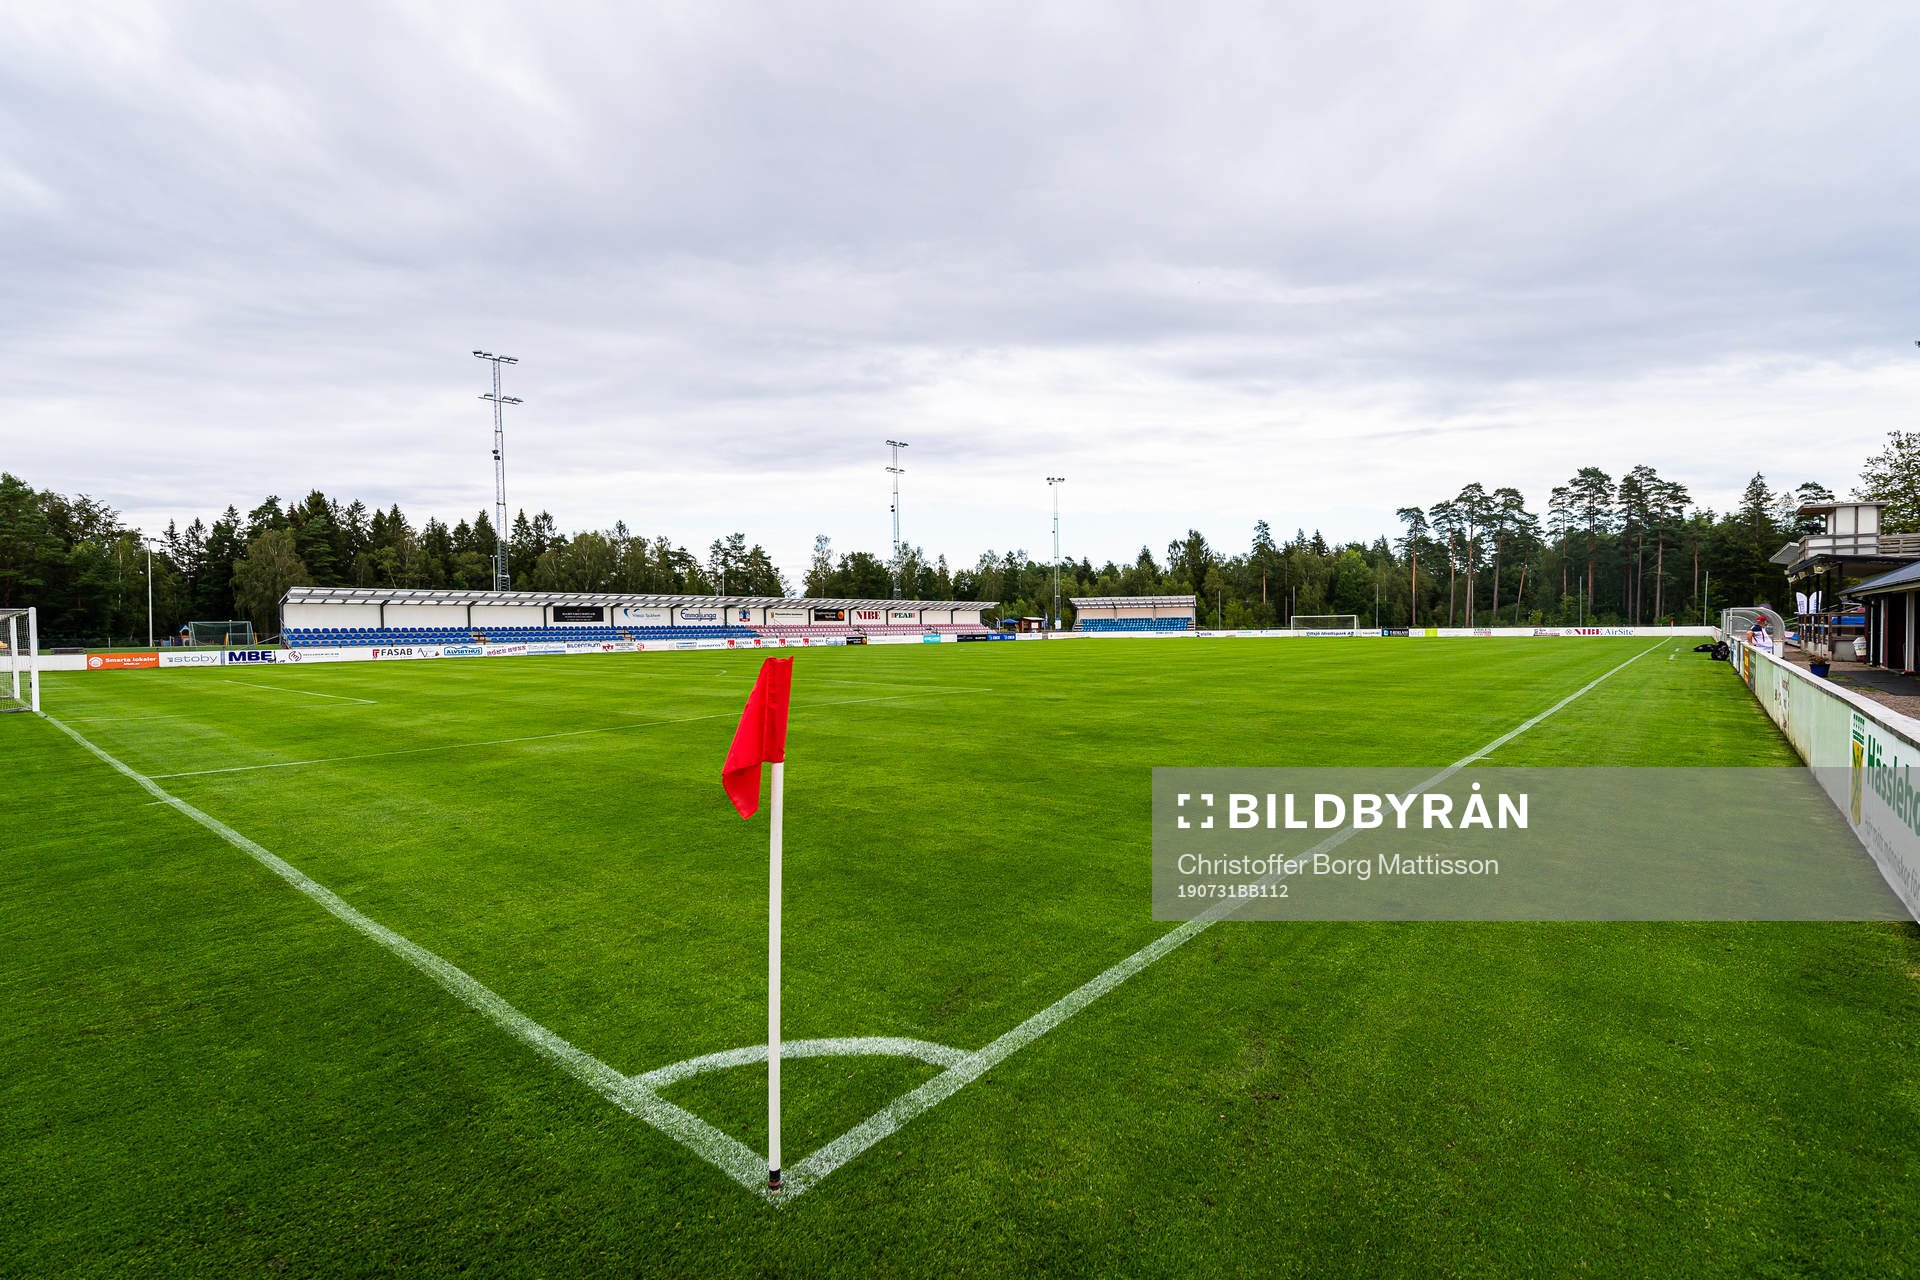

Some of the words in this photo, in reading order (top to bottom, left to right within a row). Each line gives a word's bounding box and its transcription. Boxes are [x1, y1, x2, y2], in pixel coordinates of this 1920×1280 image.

[856, 611, 880, 620] NIBE
[1605, 628, 1634, 636] AirSite
[228, 650, 272, 662] MBE
[381, 648, 413, 656] FASAB
